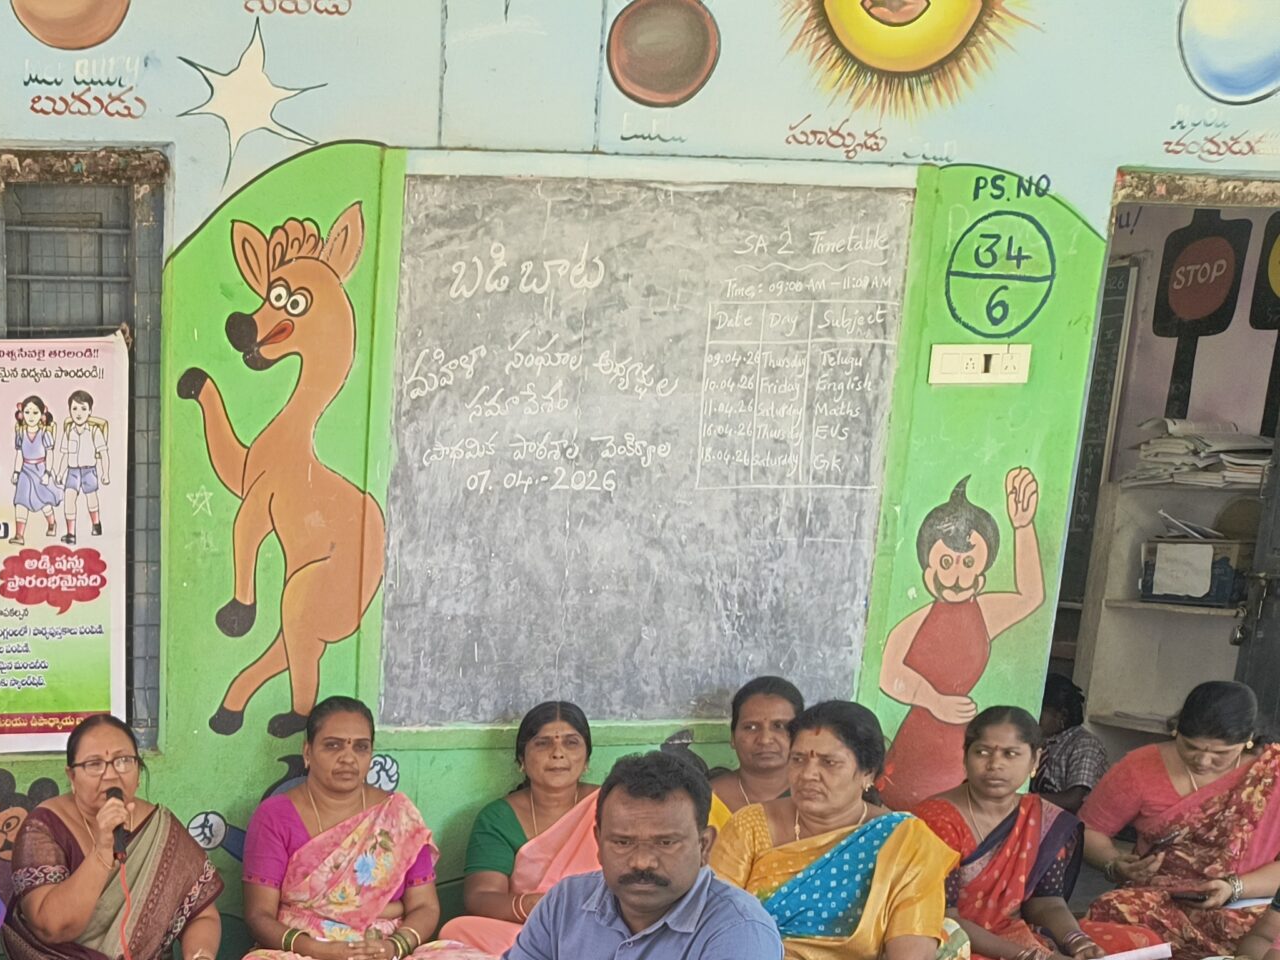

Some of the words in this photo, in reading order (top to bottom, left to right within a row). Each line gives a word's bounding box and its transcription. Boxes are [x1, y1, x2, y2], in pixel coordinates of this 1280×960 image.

[733, 234, 768, 256] SA
[777, 228, 794, 254] 2
[809, 224, 890, 255] Timetable
[974, 233, 1032, 269] 34
[1173, 259, 1227, 290] STOP
[986, 285, 1009, 326] 6
[715, 308, 753, 330] Date
[769, 312, 800, 337] Day
[818, 305, 887, 335] Subject
[21, 368, 52, 383] విద్యను
[821, 348, 863, 375] Telugu
[760, 379, 801, 402] Friday
[816, 373, 872, 402] English
[814, 402, 860, 417] Maths
[815, 424, 850, 440] EVS
